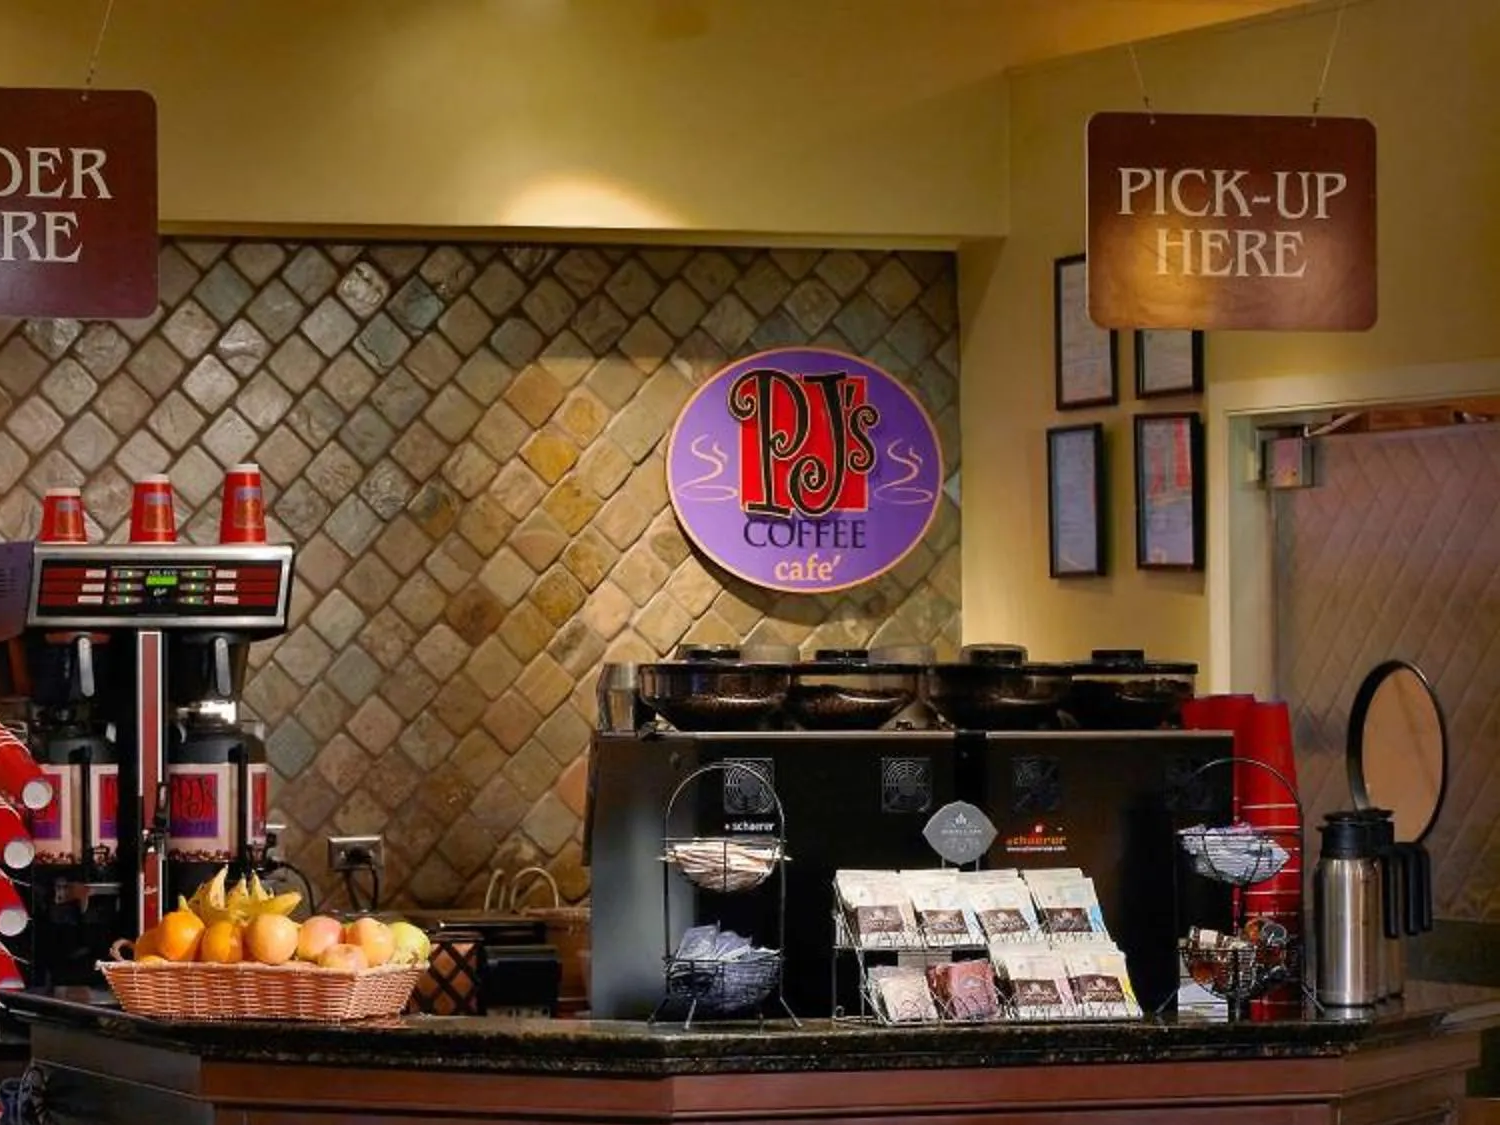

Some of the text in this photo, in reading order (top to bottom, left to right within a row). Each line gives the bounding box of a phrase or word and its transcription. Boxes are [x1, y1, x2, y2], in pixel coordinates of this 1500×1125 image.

[1117, 167, 1347, 219] PICK-UP
[1156, 229, 1308, 278] HERE
[728, 369, 880, 518] PJ's
[743, 519, 866, 548] COFFEE
